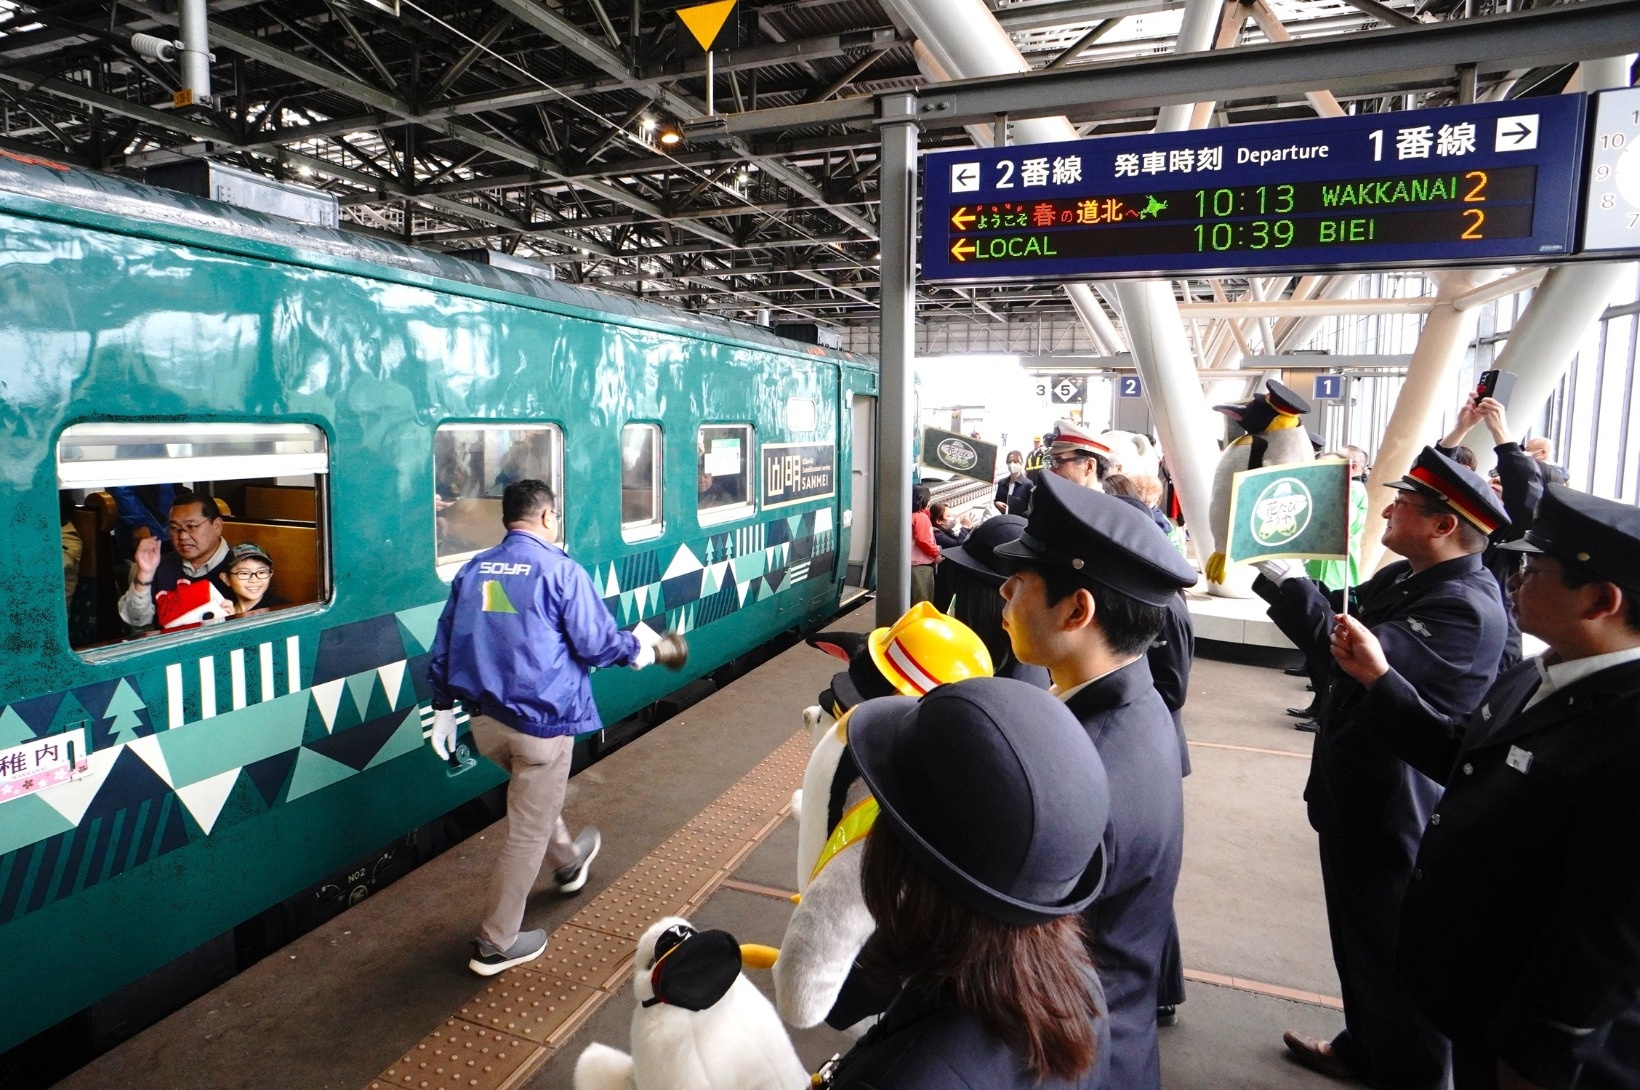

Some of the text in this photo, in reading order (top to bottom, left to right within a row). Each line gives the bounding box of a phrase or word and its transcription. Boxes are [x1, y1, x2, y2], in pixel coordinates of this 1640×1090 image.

[1368, 122, 1476, 162] 1番線
[1601, 133, 1625, 149] 10
[1114, 146, 1223, 178] 発車時刻
[1237, 145, 1329, 166] Departure
[996, 155, 1082, 189] 2番線
[1597, 165, 1610, 181] 9
[1195, 171, 1488, 218] 10:13 WAKKANAI 2
[1601, 194, 1614, 209] 8
[1629, 213, 1640, 228] 7
[975, 208, 1485, 259] LOCAL 10:39 BIEI 2
[1036, 385, 1046, 396] 3
[1060, 385, 1071, 396] 5
[1125, 379, 1136, 394] 2
[1323, 379, 1332, 395] 1
[801, 473, 829, 490] SANMEI
[479, 561, 532, 576] SOYA
[0, 744, 58, 777] 稚内
